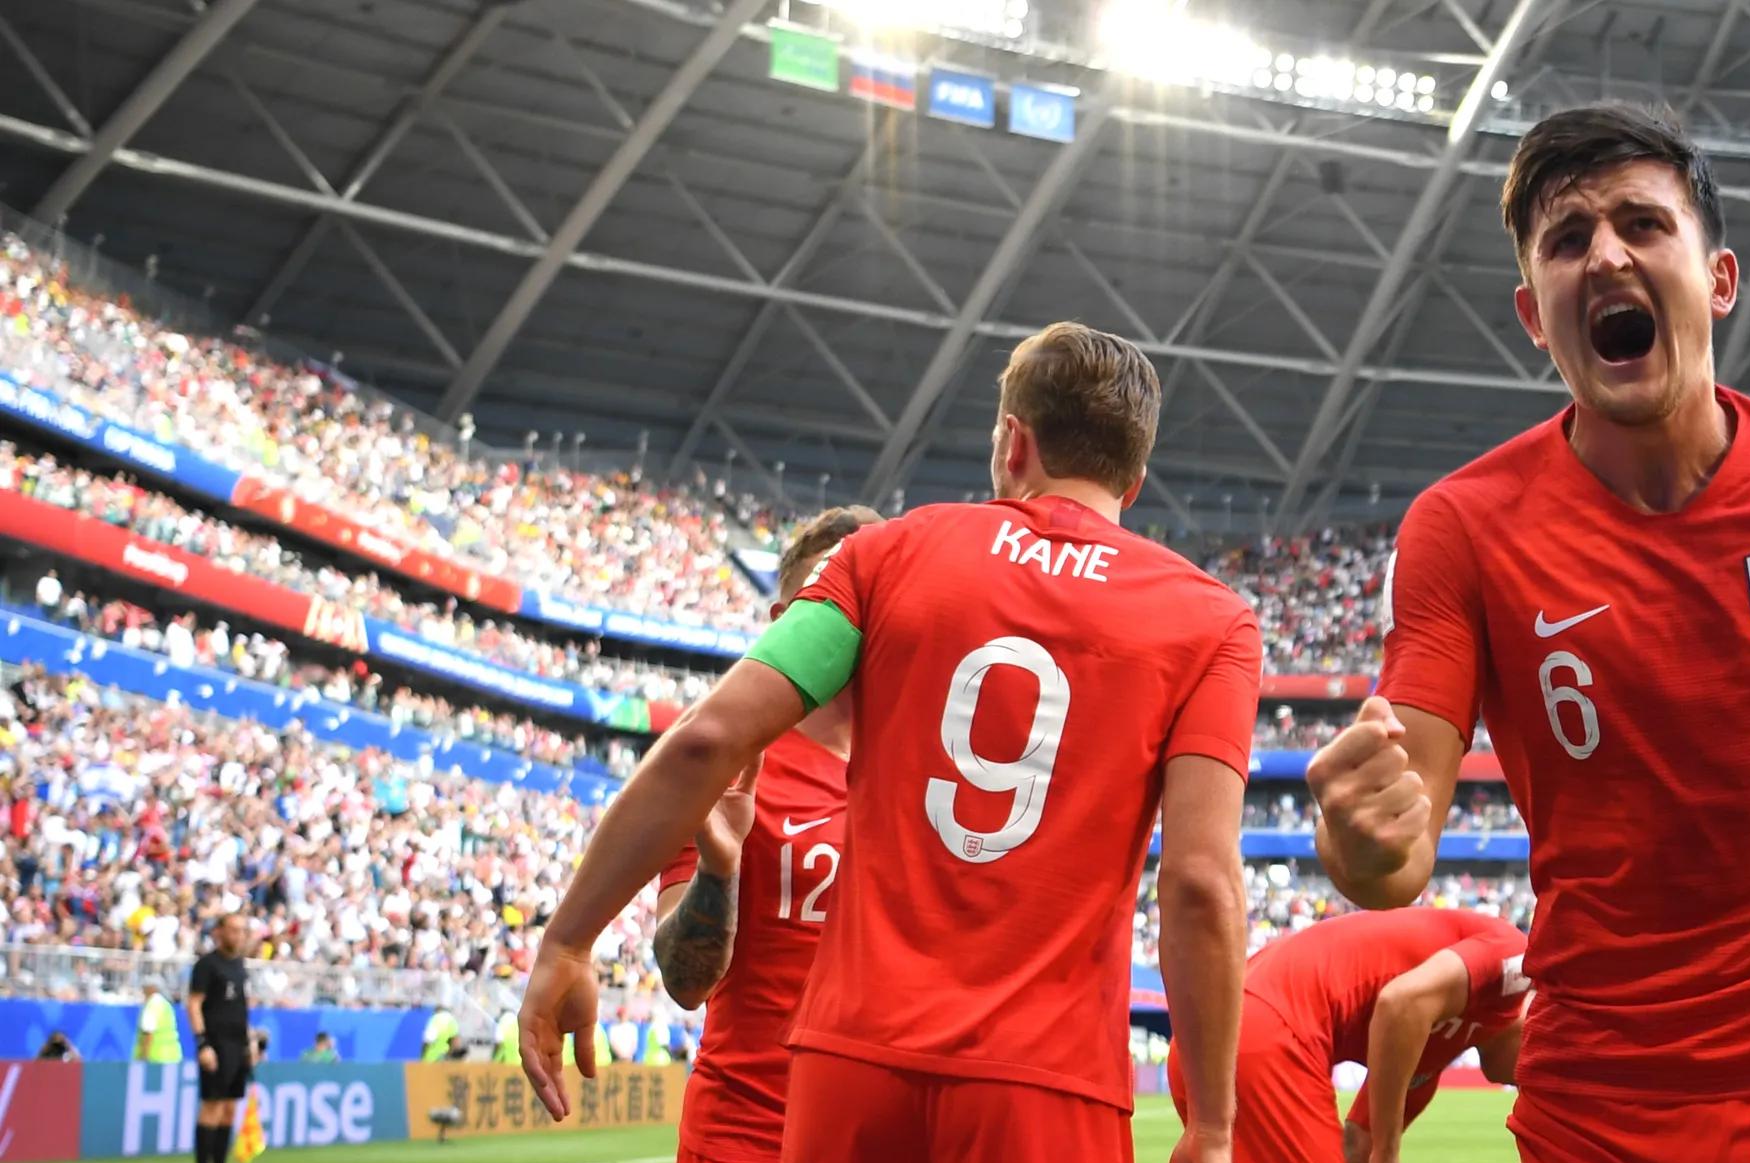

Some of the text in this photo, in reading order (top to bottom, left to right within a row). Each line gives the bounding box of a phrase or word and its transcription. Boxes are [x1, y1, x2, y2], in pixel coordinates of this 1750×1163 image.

[991, 520, 1119, 582] KANE
[925, 636, 1070, 863] 9
[1538, 650, 1600, 760] 6
[778, 842, 840, 922] 12
[122, 1060, 374, 1156] Hiense
